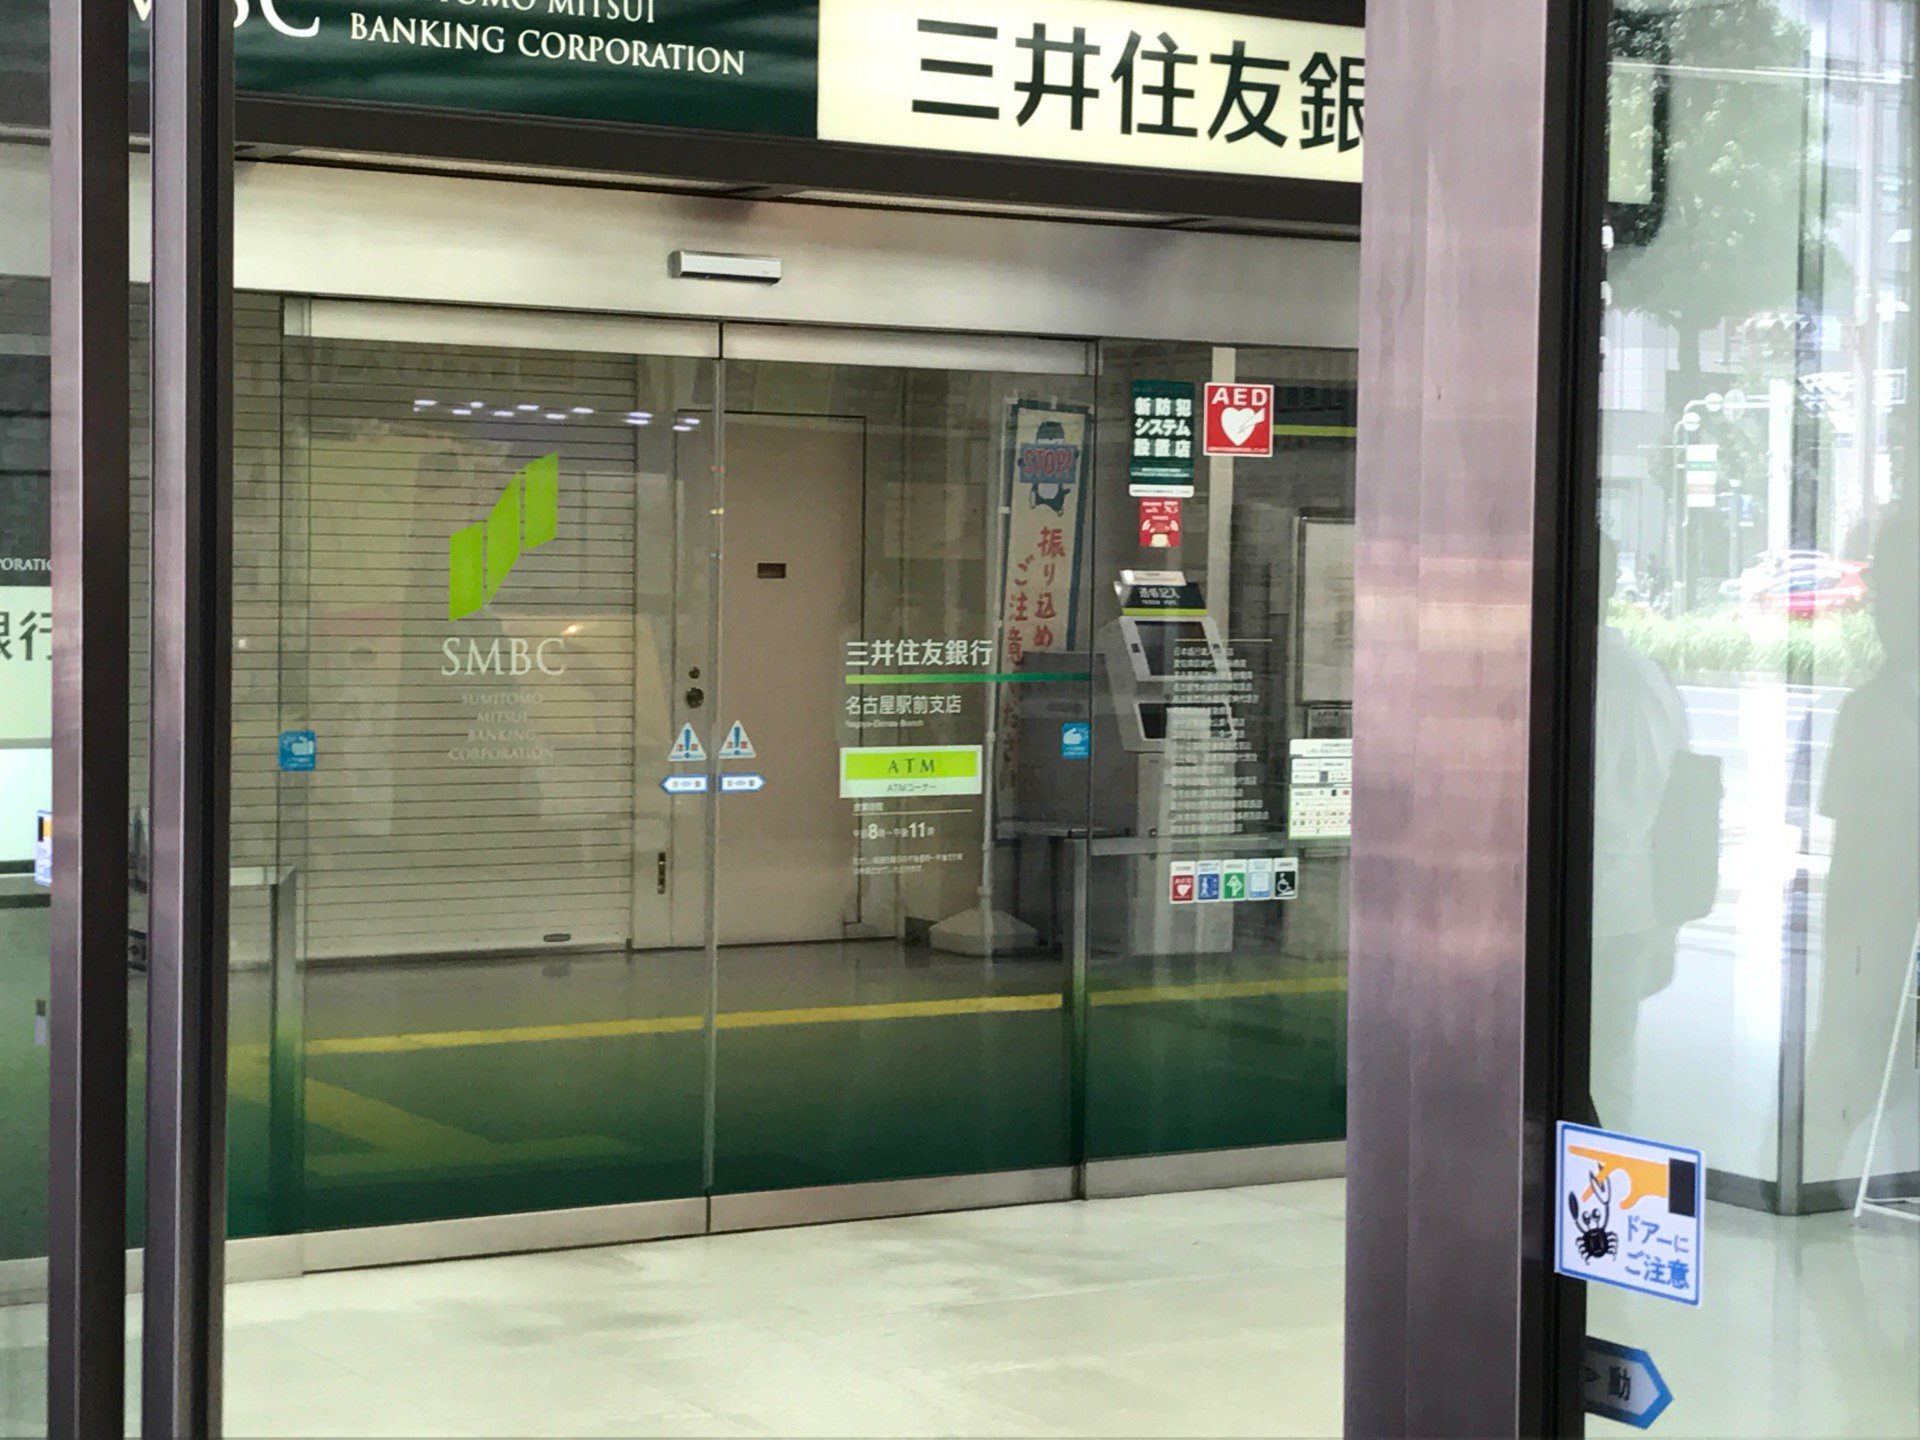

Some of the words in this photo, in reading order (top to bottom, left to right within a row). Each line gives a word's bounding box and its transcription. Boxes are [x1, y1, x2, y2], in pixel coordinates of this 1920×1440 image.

[350, 12, 505, 54] BANKING
[517, 29, 745, 76] CORPORATION
[912, 18, 1365, 153] 三井住友銀
[1211, 387, 1267, 406] AED
[1134, 418, 1192, 437] システム
[0, 557, 51, 572] ORATI
[1034, 526, 1066, 649] 振り込め
[441, 637, 566, 676] SMBC
[846, 639, 993, 666] 三井住友銀行
[461, 692, 545, 705] SUMITOMO
[845, 694, 962, 715] 名古屋駅前支店
[477, 710, 527, 724] MITSUI
[887, 758, 935, 774] ATM
[1625, 1214, 1690, 1254] ドアーに
[1624, 1250, 1691, 1291] ご注意
